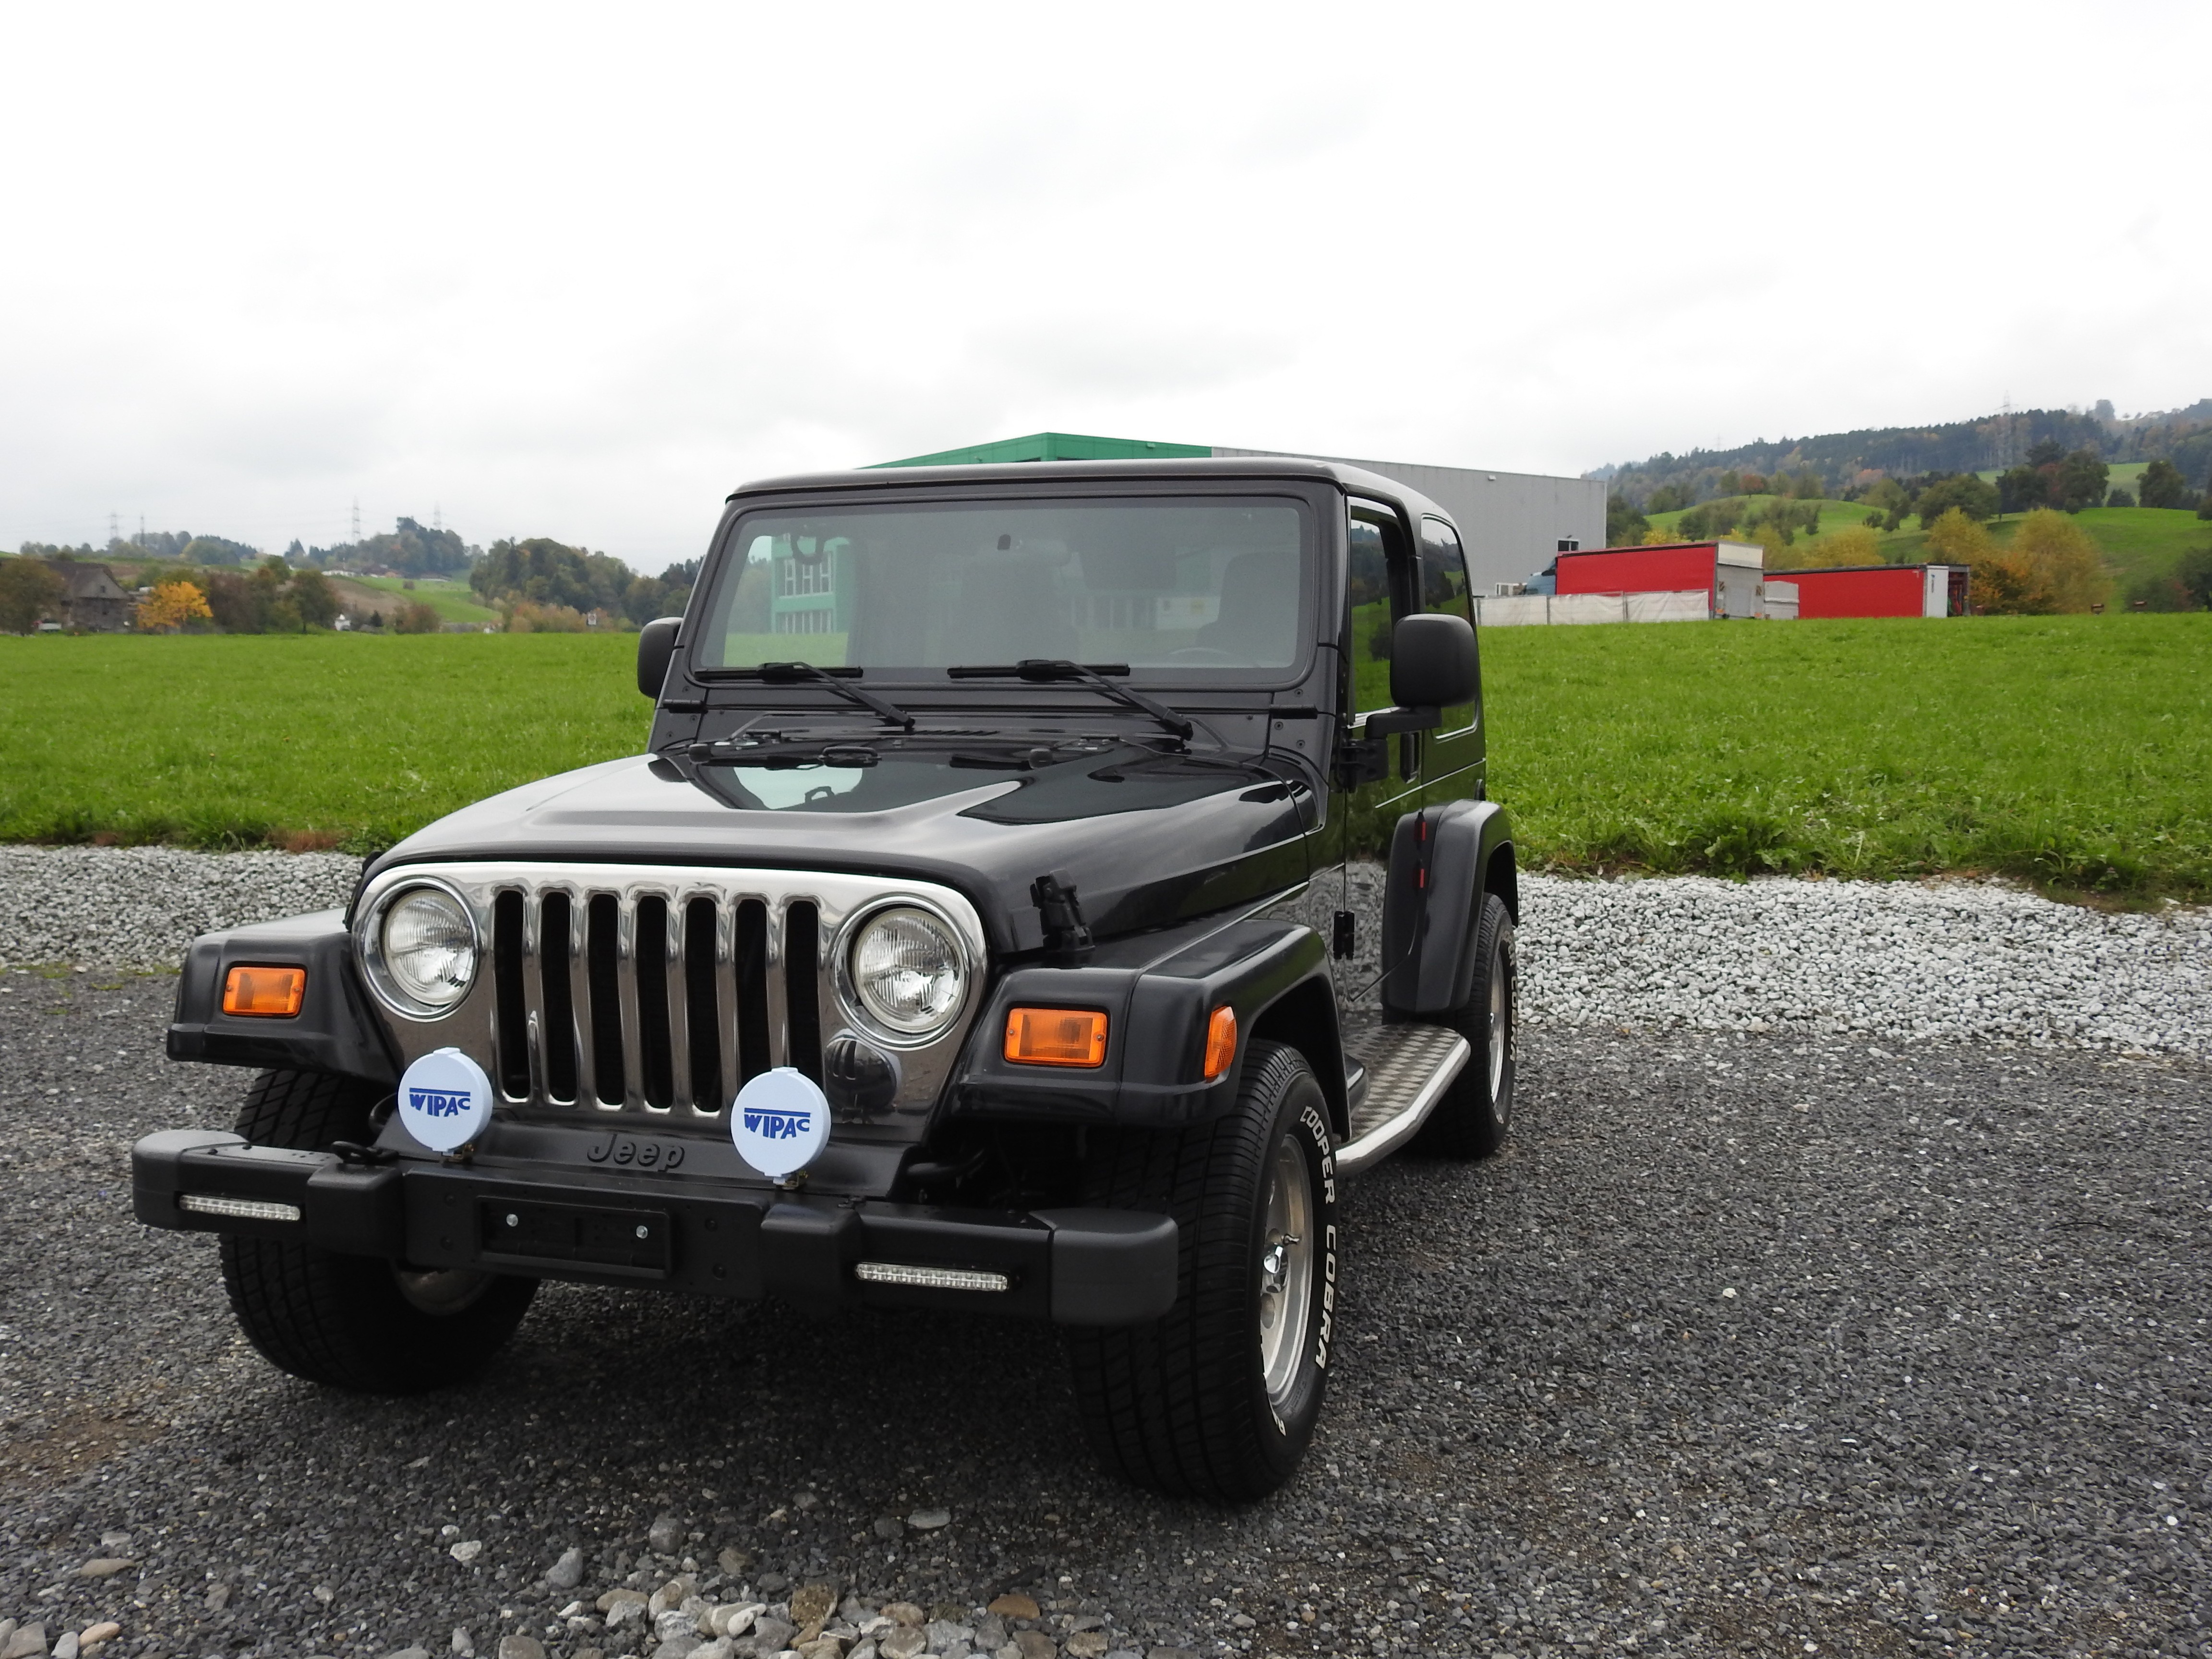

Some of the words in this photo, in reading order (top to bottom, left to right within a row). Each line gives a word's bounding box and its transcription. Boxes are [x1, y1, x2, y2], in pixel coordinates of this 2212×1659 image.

[409, 1094, 470, 1117] WIPAC
[744, 1114, 810, 1139] WIPAC
[587, 1134, 685, 1172] Jeep
[1300, 1106, 1335, 1204] COOPER
[1316, 1225, 1336, 1369] COBRA
